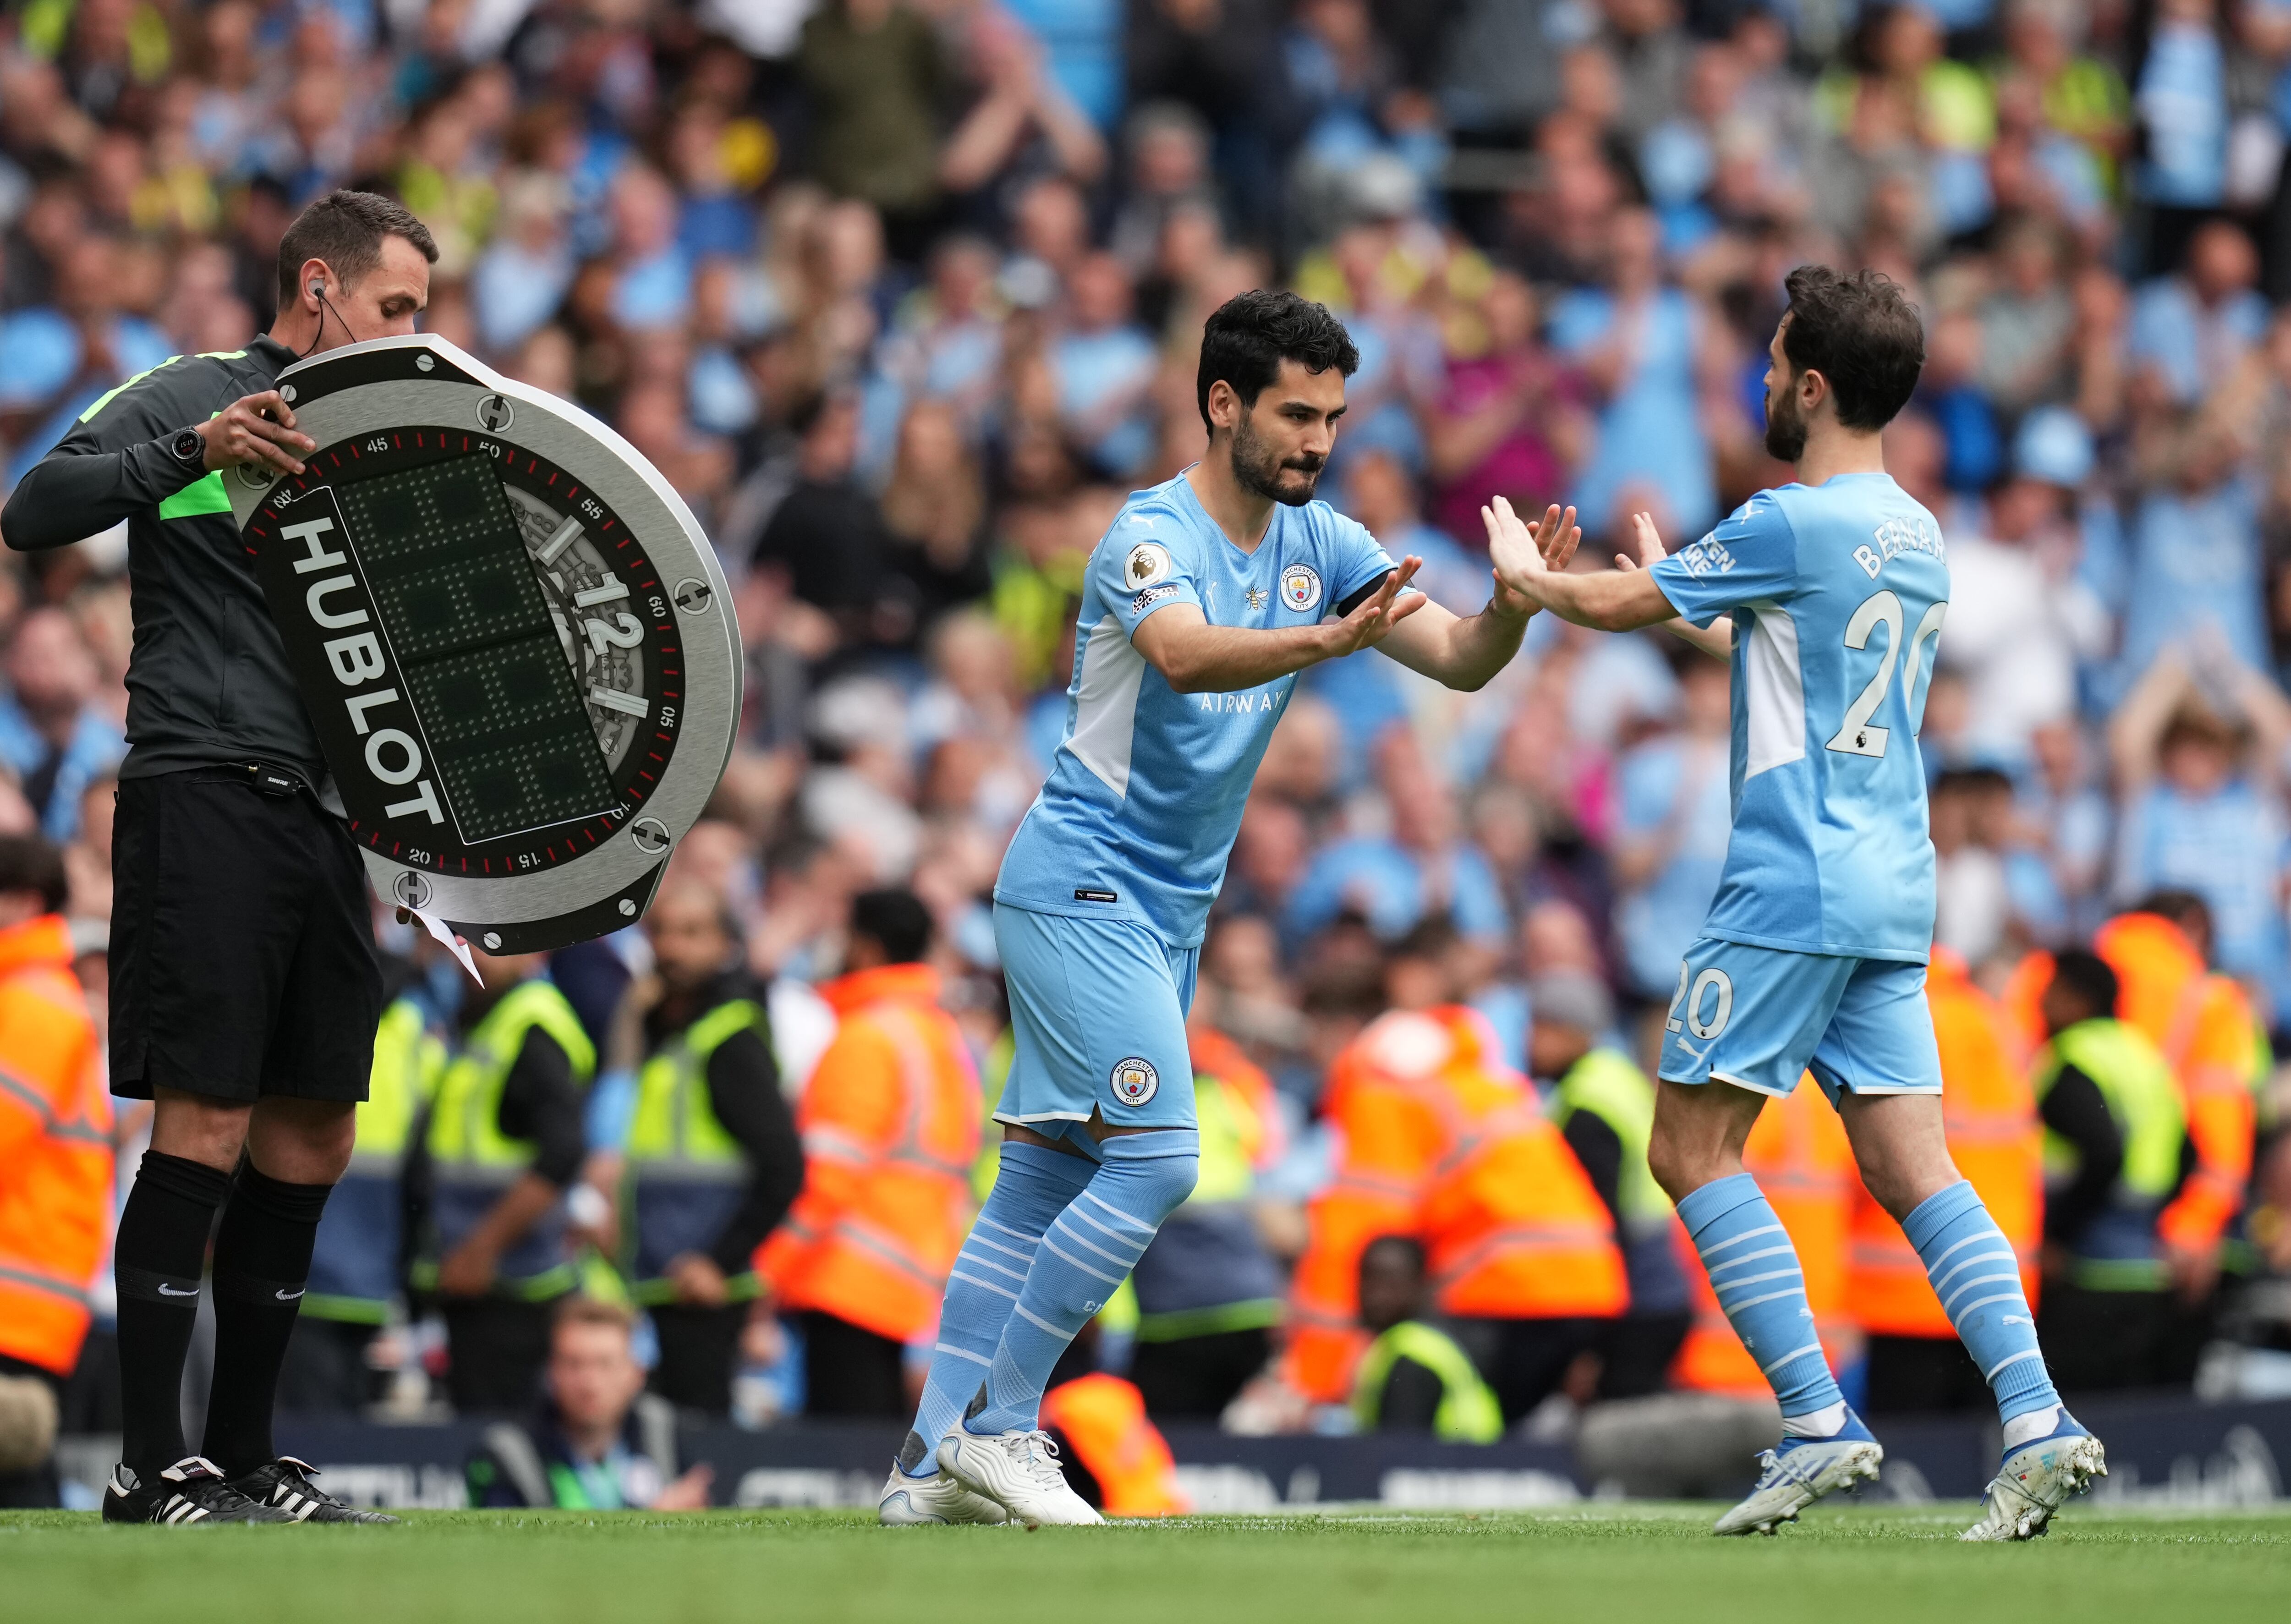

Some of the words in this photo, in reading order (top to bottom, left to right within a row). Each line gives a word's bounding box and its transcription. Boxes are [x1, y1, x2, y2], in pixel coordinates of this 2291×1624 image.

[367, 437, 388, 452] 45
[581, 498, 604, 519] 55
[1852, 517, 1947, 581] BERNAR
[1282, 567, 1316, 583] MANCHESTER
[648, 596, 666, 617] 60
[1132, 595, 1144, 609] No
[1142, 587, 1173, 599] room
[1145, 591, 1180, 607] racism
[574, 571, 645, 656] 12
[280, 517, 445, 824] HUBLOT
[1825, 589, 1948, 758] 20
[1200, 688, 1287, 713] AIRWAY
[660, 706, 676, 728] 05
[267, 776, 289, 786] SHURE
[408, 848, 430, 865] 20
[518, 852, 541, 868] 15
[1666, 958, 1733, 1040] 20
[1116, 1061, 1154, 1077] MANCHESTER
[149, 1498, 161, 1509] COPA
